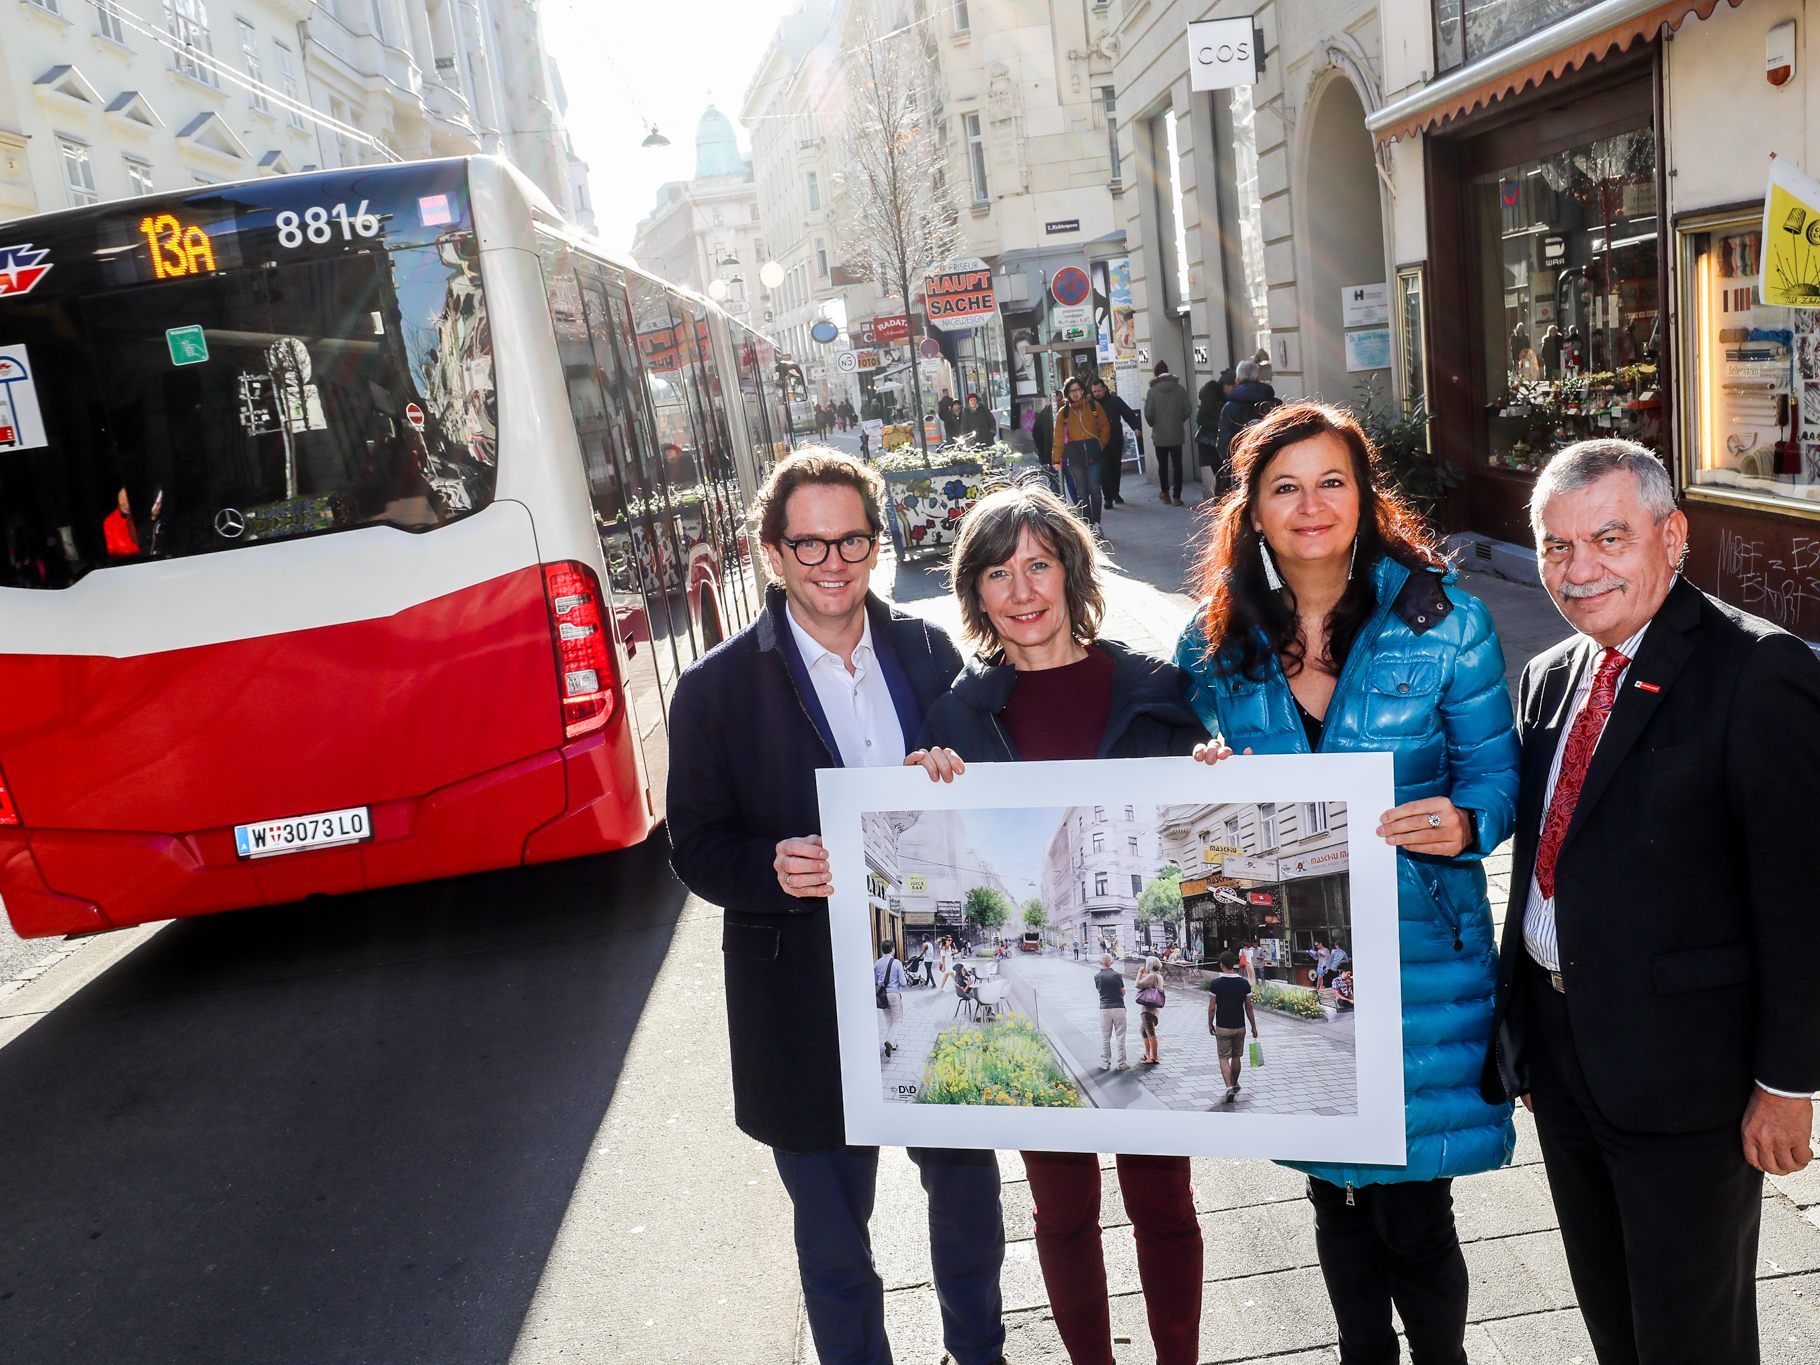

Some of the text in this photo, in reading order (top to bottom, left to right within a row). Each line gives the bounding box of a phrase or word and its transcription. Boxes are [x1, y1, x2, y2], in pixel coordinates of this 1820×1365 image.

[1198, 42, 1250, 65] COS
[275, 199, 379, 249] 8816
[139, 213, 217, 279] 13A
[926, 271, 991, 295] HAUPT
[930, 294, 993, 315] SACHE
[877, 319, 908, 331] RADAT
[858, 357, 881, 369] FOTOS
[252, 827, 267, 848] W
[283, 818, 334, 844] 3073
[1310, 852, 1338, 865] MASCHU
